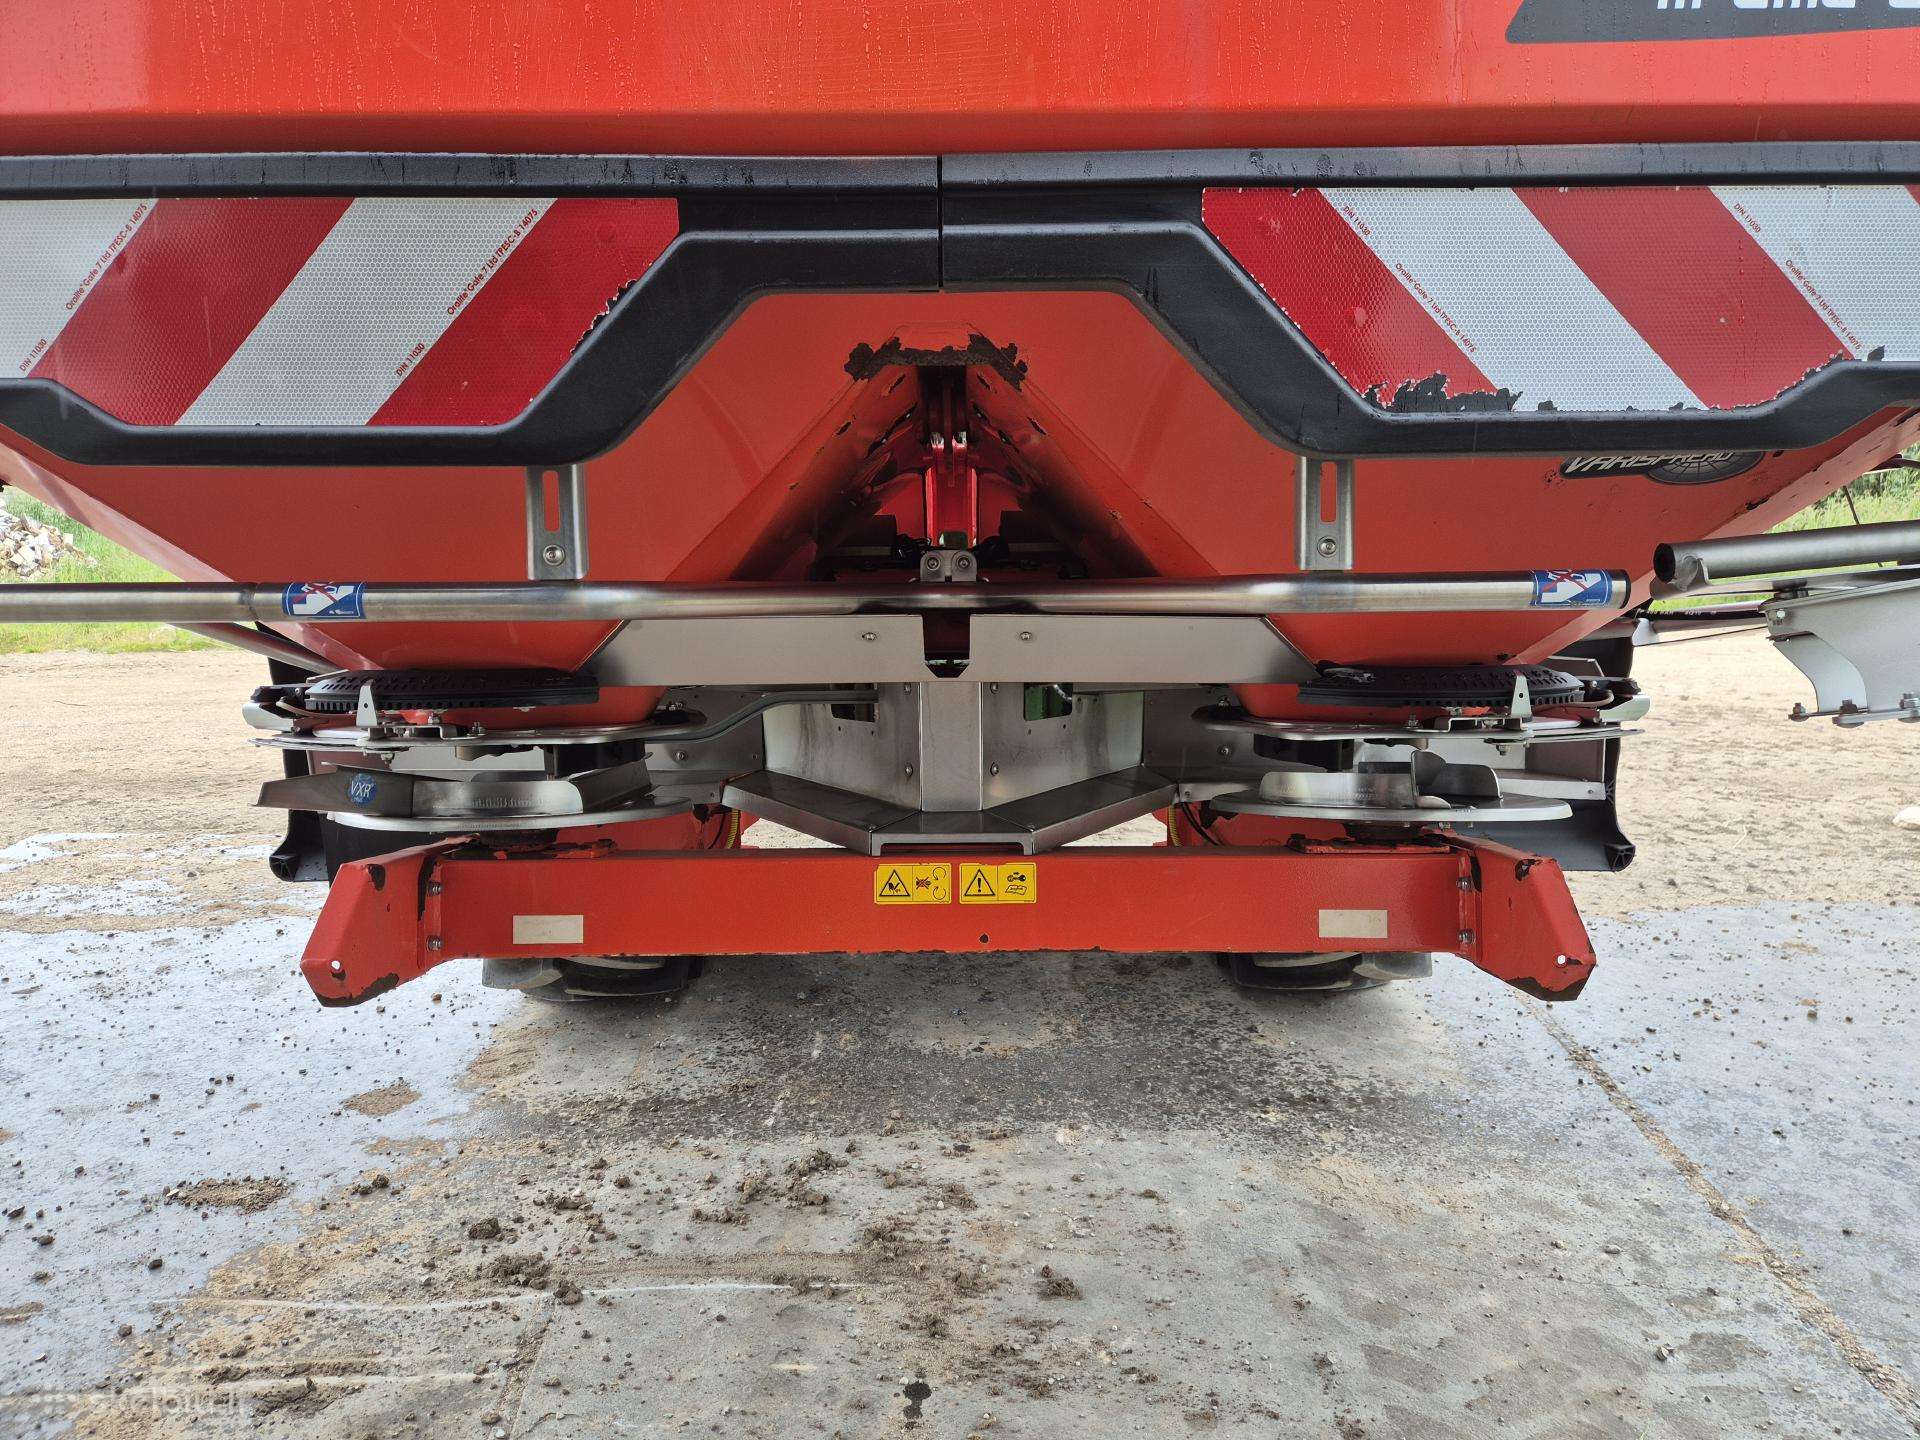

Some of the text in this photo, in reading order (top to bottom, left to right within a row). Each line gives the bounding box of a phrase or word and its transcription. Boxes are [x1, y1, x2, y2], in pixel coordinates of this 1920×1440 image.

[1343, 206, 1354, 217] DIN
[1734, 204, 1744, 214] DIN
[467, 273, 483, 291] Gate
[486, 256, 497, 267] Ltd
[1413, 283, 1428, 298] Gate
[20, 358, 31, 370] DIN
[396, 363, 407, 375] DIN
